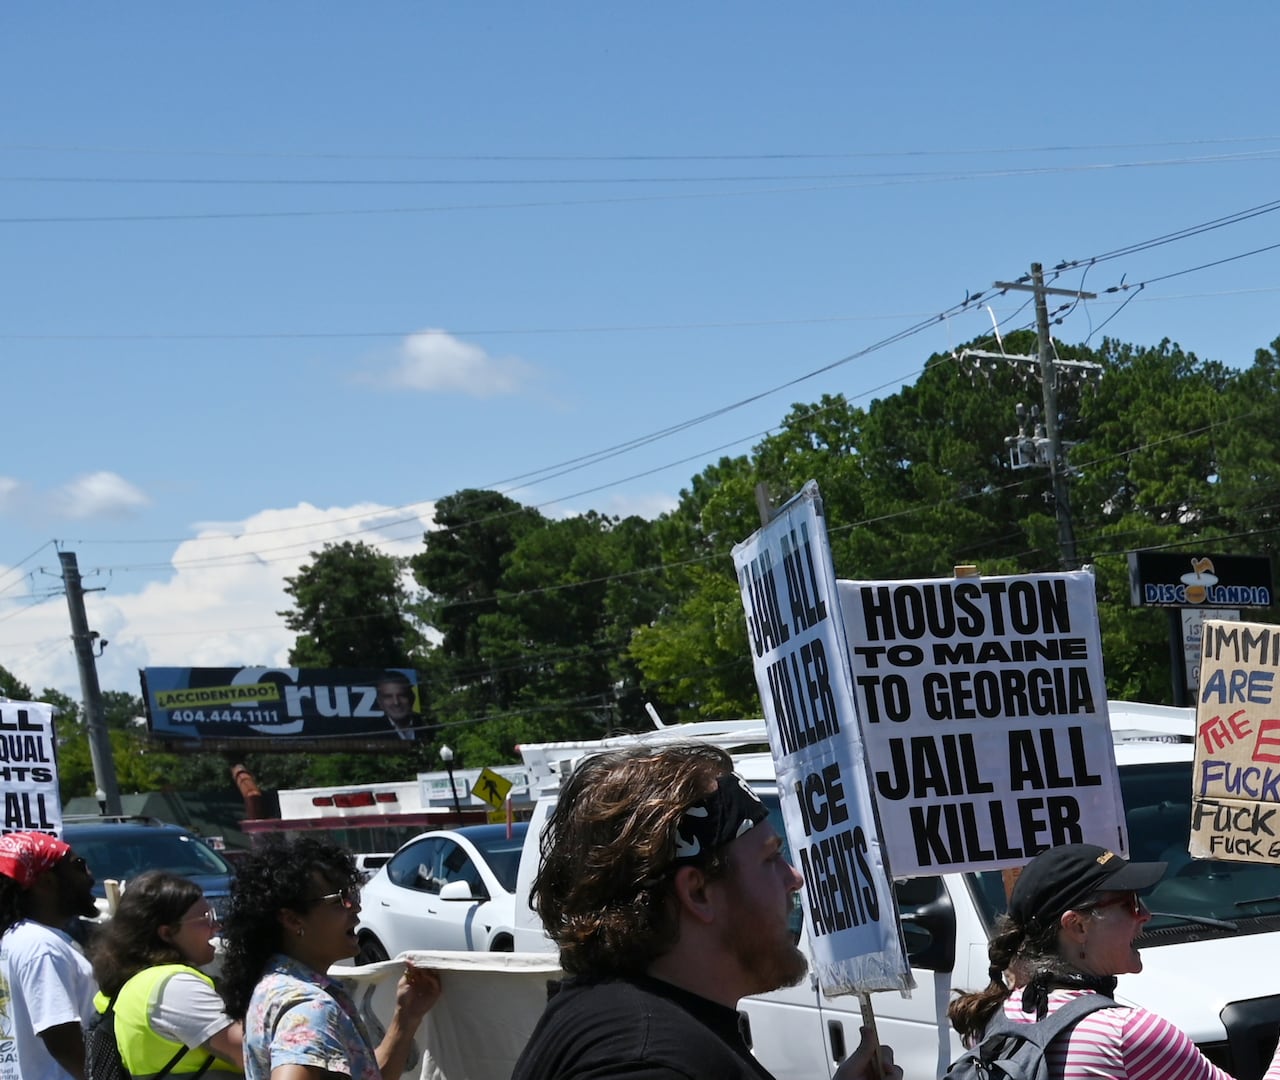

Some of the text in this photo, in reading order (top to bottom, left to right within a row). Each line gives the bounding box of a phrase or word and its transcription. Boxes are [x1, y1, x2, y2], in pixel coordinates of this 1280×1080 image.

[742, 522, 827, 658] JAIL ALL
[860, 580, 1070, 641] HOUSTON
[854, 638, 1088, 669] TO MAINE
[158, 685, 276, 707] ¿ACCIDENTADO?
[231, 668, 384, 734] Cruz
[766, 638, 840, 756] KILLER
[857, 667, 1095, 724] TO GEORGIA
[1203, 669, 1274, 704] ARE
[172, 710, 278, 722] 404.444.1111
[1200, 709, 1252, 755] THE
[876, 726, 1102, 800] JAIL ALL
[5, 792, 54, 829] ALL
[795, 762, 849, 837] ICE
[1193, 801, 1276, 836] FUCK
[909, 796, 1083, 867] KILLER
[1210, 835, 1264, 857] FUCK
[800, 825, 879, 937] AGENTS
